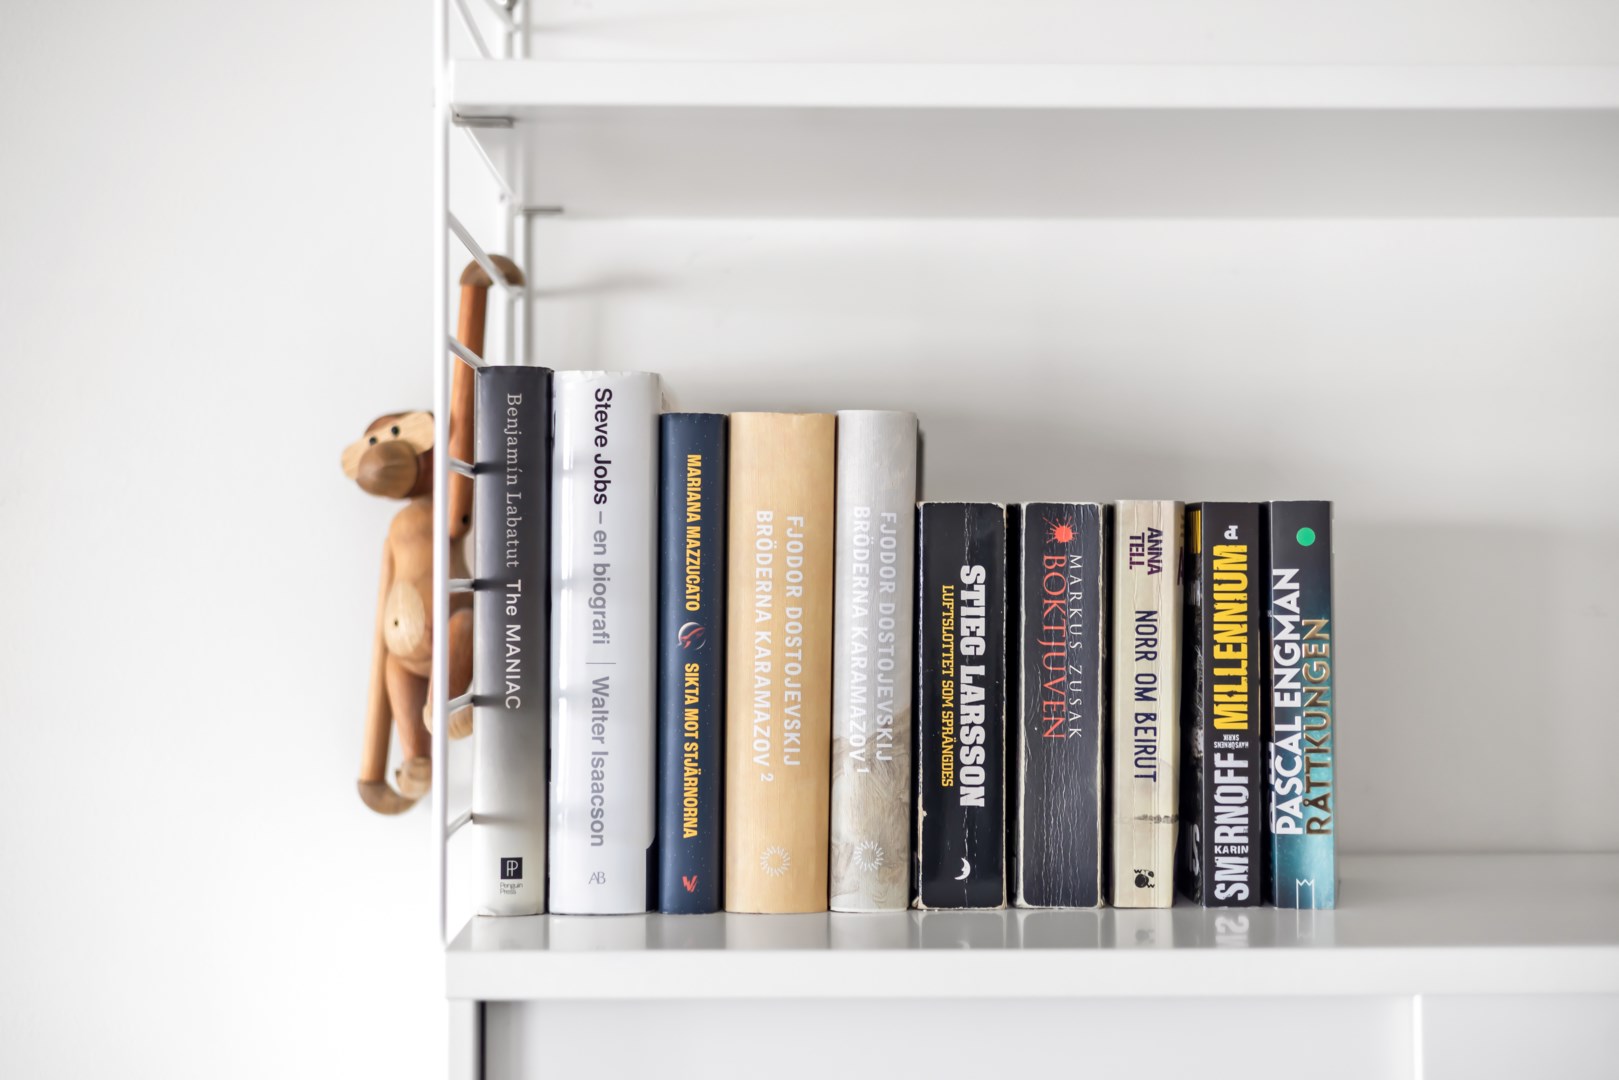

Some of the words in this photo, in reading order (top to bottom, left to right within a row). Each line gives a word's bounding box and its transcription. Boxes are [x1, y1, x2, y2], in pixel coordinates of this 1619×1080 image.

[503, 393, 524, 486] Benjamín
[593, 388, 613, 448] Steve
[593, 453, 613, 505] Jobs
[687, 454, 702, 522] MARIANA
[505, 492, 522, 568] Labatut
[593, 530, 607, 556] en
[685, 525, 702, 611] MAZZUCATO
[754, 510, 777, 623] BRÖDERNA
[784, 515, 805, 598] FJODOR
[851, 506, 875, 618] BRÖDERNA
[878, 511, 898, 593] FJODOR
[1129, 532, 1145, 570] TELL
[1147, 526, 1163, 576] ANNA
[505, 579, 522, 617] The
[586, 562, 612, 645] biografi
[941, 584, 955, 675] LUFTSLOTTET
[959, 564, 986, 656] STIEG
[1068, 554, 1083, 650] MARKUS
[1134, 609, 1158, 662] NORR
[1212, 544, 1249, 730] MILLENNIUM
[1272, 568, 1303, 708] ENGMAN
[504, 623, 522, 710] MANIAC
[684, 662, 700, 706] SIKTA
[782, 606, 803, 766] DOSTOJEVSKIJ
[875, 602, 896, 761] DOSTOJEVSKIJ
[1036, 554, 1068, 740] BOKTJUVEN
[1134, 673, 1158, 703] OM
[590, 676, 611, 744] Walter
[684, 708, 699, 739] MOT
[752, 630, 773, 767] KARAMAZOV
[848, 625, 870, 761] KARAMAZOV
[941, 679, 955, 708] SOM
[1068, 664, 1082, 740] ZUSAK
[1302, 618, 1332, 836] RÅTTKUNGEN
[856, 766, 870, 774] 1
[940, 711, 957, 787] SPRÄNGDES
[958, 664, 986, 808] LARSSON
[1133, 712, 1157, 783] BEIRUT
[1222, 733, 1240, 741] SKRIK
[1273, 715, 1304, 835] PASCAL
[589, 750, 610, 847] Isaacson
[682, 741, 701, 839] STJÄRNORNA
[760, 772, 774, 783] 2
[1214, 844, 1249, 854] KARIN
